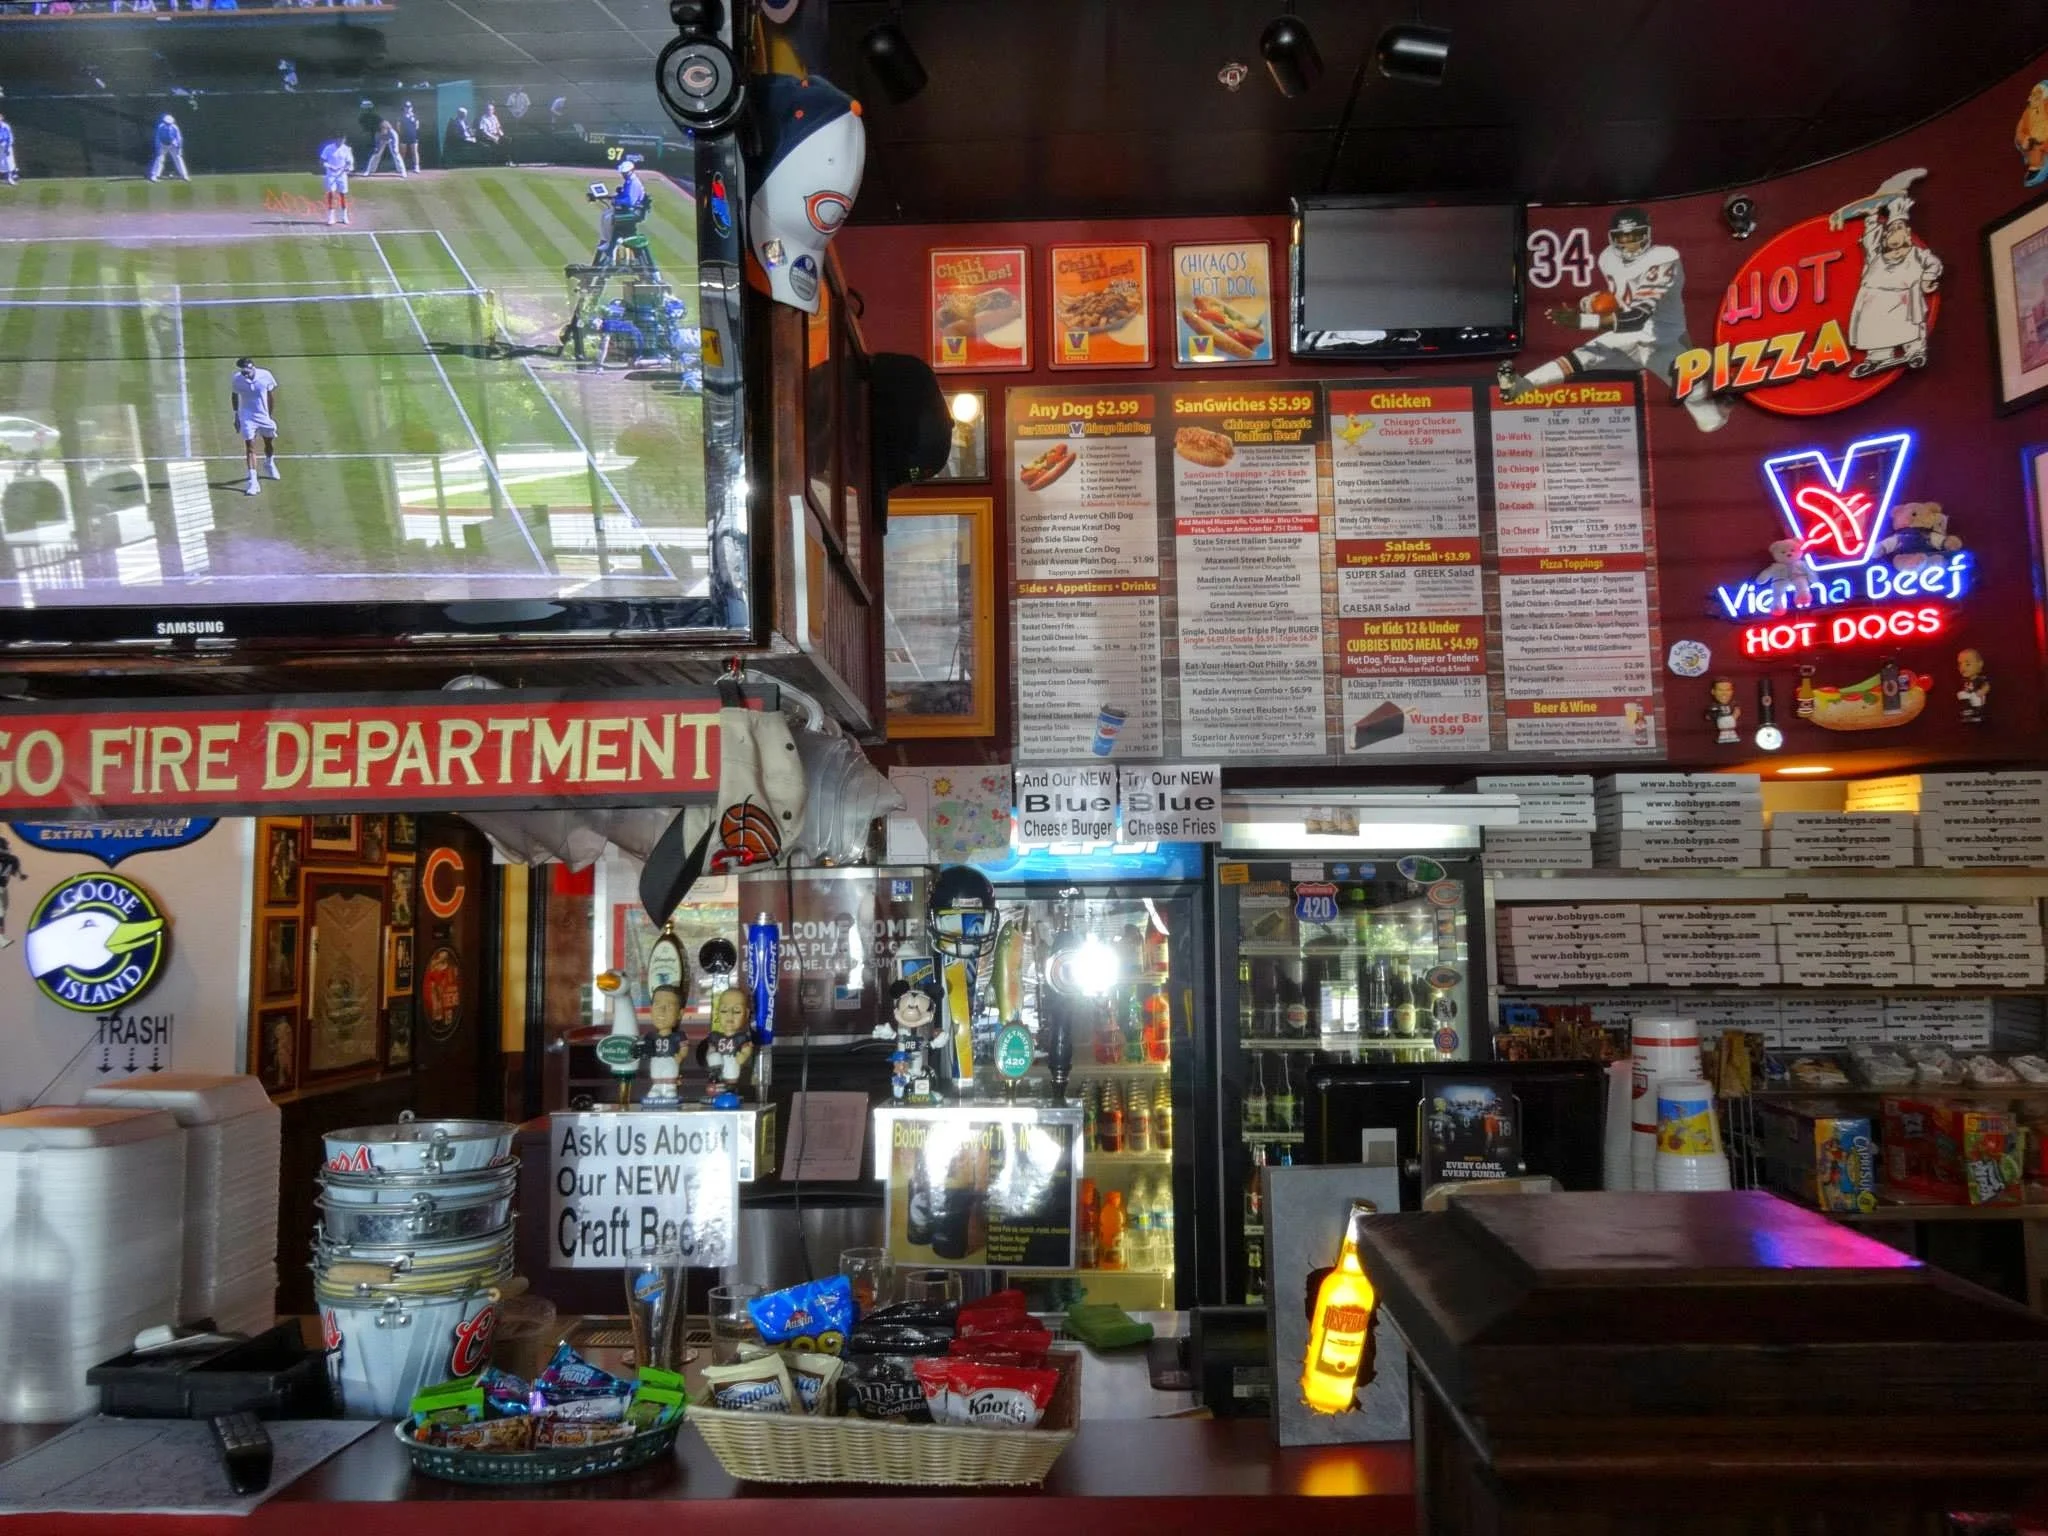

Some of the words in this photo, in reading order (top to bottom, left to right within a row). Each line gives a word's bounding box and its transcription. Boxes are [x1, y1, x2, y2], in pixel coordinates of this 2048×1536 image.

[608, 147, 624, 160] 97
[1181, 251, 1247, 275] CHICAGO'S
[1527, 229, 1593, 288] 34
[1193, 277, 1221, 296] HOT
[1227, 276, 1255, 296] DOG
[1722, 250, 1842, 326] HOT
[1674, 319, 1852, 401] PIZZA
[1580, 387, 1621, 402] Pizza
[1175, 397, 1265, 413] SanGwiches
[1269, 396, 1311, 412] $5.99
[1371, 394, 1431, 409] Chicken
[1029, 403, 1059, 419] Any
[1062, 402, 1093, 418] Dog
[1096, 400, 1139, 416] $2.99
[1379, 428, 1415, 436] Chicken
[1021, 513, 1067, 521] Cumberland
[1118, 512, 1133, 521] Dog
[1063, 535, 1080, 543] Slaw
[1082, 535, 1097, 543] Dog
[1193, 537, 1214, 545] State
[1216, 537, 1240, 545] Street
[1242, 536, 1267, 544] Italian
[1269, 536, 1302, 546] Sausage
[1385, 541, 1431, 551] Salads
[1266, 555, 1291, 563] Polish
[1347, 554, 1374, 565] Large
[1380, 553, 1405, 563] $7.99
[1412, 552, 1437, 562] Small
[1444, 552, 1471, 562] $3.99
[1540, 560, 1563, 569] Pizza
[1563, 558, 1604, 570] Toppings
[1346, 571, 1377, 579] SUPER
[1380, 569, 1406, 578] Salad
[1414, 569, 1446, 578] GREEK
[1448, 568, 1474, 577] Salad
[1866, 553, 1967, 599] Beef
[1020, 584, 1048, 593] Sides
[1056, 582, 1113, 594] Appetizers
[1121, 581, 1157, 591] Drinks
[1343, 604, 1382, 613] CAESAR
[1385, 603, 1411, 612] Salad
[157, 621, 224, 634] SAMSUNG
[1364, 623, 1381, 635] For
[1382, 622, 1403, 634] Kids
[1406, 622, 1417, 633] 12
[1418, 622, 1428, 633] &
[1429, 621, 1460, 633] Under
[1746, 622, 1817, 654] HOT
[1832, 608, 1940, 645] DOGS
[1347, 639, 1389, 652] CUBBIES
[1391, 639, 1413, 651] KIDS
[1415, 638, 1443, 651] MEAL
[1450, 637, 1479, 651] $4.99
[1348, 656, 1362, 664] Hot
[1408, 654, 1435, 664] Burger
[1437, 655, 1445, 663] or
[1447, 653, 1479, 662] Tenders
[1534, 702, 1558, 713] Beer
[1559, 702, 1569, 713] &
[1570, 701, 1597, 712] Wine
[1410, 713, 1460, 724] Wunder
[1463, 712, 1483, 722] Bar
[1430, 725, 1465, 735] $3.99
[89, 720, 240, 796] FIRE
[261, 713, 720, 790] DEPARTMENT
[1022, 774, 1048, 787] And
[1052, 773, 1076, 787] Our
[1080, 772, 1111, 786] NEW
[1126, 772, 1146, 789] Try
[1152, 772, 1176, 786] Our
[1181, 771, 1214, 785] NEW
[1640, 780, 1737, 789] www.bobbygs.com
[1025, 794, 1111, 812] Blue
[1129, 793, 1215, 811] Blue
[1646, 800, 1741, 809] www.bobbygs.com
[1024, 820, 1068, 836] Cheese
[1072, 819, 1112, 839] Burger
[1128, 819, 1178, 836] Cheese
[1183, 818, 1216, 835] Fries
[1646, 819, 1741, 828] www.bobbygs.com
[40, 829, 94, 840] EXTRA
[102, 829, 144, 839] PALE
[151, 826, 184, 838] ALE
[1644, 855, 1738, 864] www.bobbygs.com
[1794, 853, 1890, 862] www.bobbygs.com
[58, 880, 140, 915] GOOSE
[1303, 897, 1330, 918] 420
[1787, 909, 1888, 919] www.bobbygs.com
[1528, 911, 1625, 921] www.bobbygs.com
[1658, 911, 1756, 920] www.bobbygs.com
[1528, 931, 1626, 941] www.bobbygs.com
[1662, 932, 1761, 941] www.bobbygs.com
[1794, 930, 1893, 939] www.bobbygs.com
[1531, 951, 1629, 960] www.bobbygs.com
[1662, 951, 1761, 960] www.bobbygs.com
[1796, 949, 1895, 959] www.bobbygs.com
[767, 940, 778, 996] LIGHT
[1665, 970, 1765, 979] www.bobbygs.com
[1533, 971, 1633, 980] www.bobbygs.com
[56, 964, 142, 1004] ISLAND
[766, 999, 776, 1032] BUD
[96, 1015, 168, 1045] TRASH
[656, 1039, 670, 1052] 99
[718, 1039, 735, 1053] 54
[1005, 1058, 1025, 1066] 420
[560, 1126, 607, 1157] Ask
[616, 1125, 647, 1156] Us
[654, 1125, 729, 1155] About
[1446, 1161, 1474, 1170] EVERY
[1476, 1161, 1503, 1170] GAME.
[1442, 1170, 1470, 1178] EVERY
[557, 1166, 606, 1197] Our
[616, 1165, 681, 1195] NEW
[558, 1206, 630, 1258] Craft
[784, 1315, 814, 1332] Austin
[558, 1372, 592, 1386] TREATS
[877, 1403, 928, 1415] Cookies
